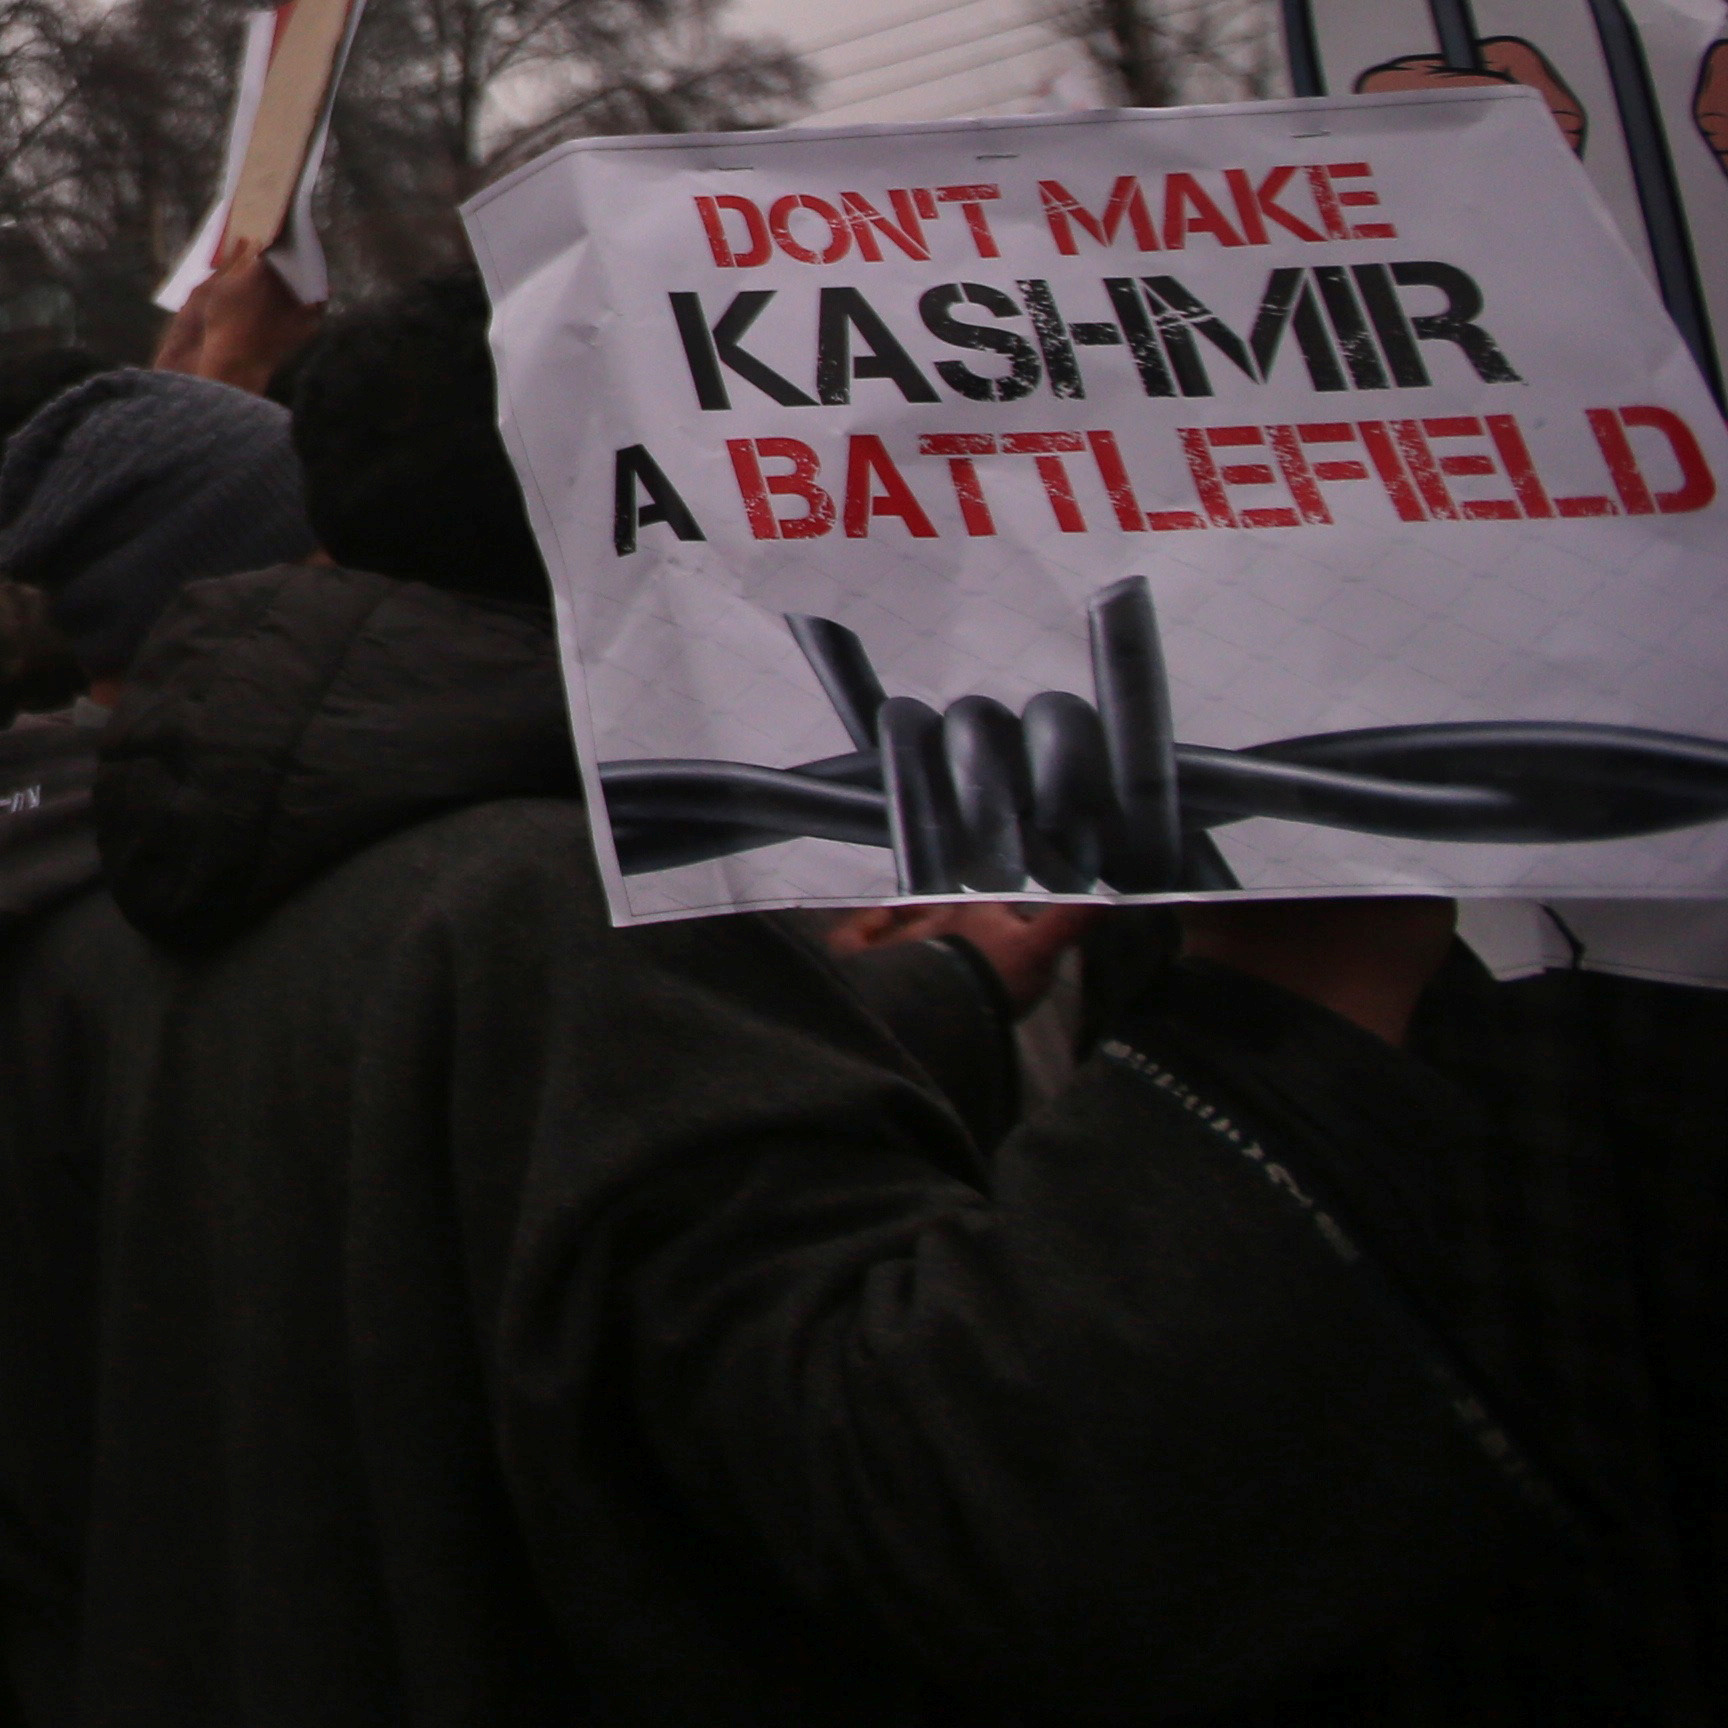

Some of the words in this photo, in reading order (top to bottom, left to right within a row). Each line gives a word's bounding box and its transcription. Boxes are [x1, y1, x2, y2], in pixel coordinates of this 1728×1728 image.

[693, 184, 1002, 269] DON'T
[1038, 162, 1398, 257] MAKE
[668, 260, 1524, 412] KASHMIR
[613, 443, 707, 558] A
[724, 405, 1716, 540] BATTLEFIELD
